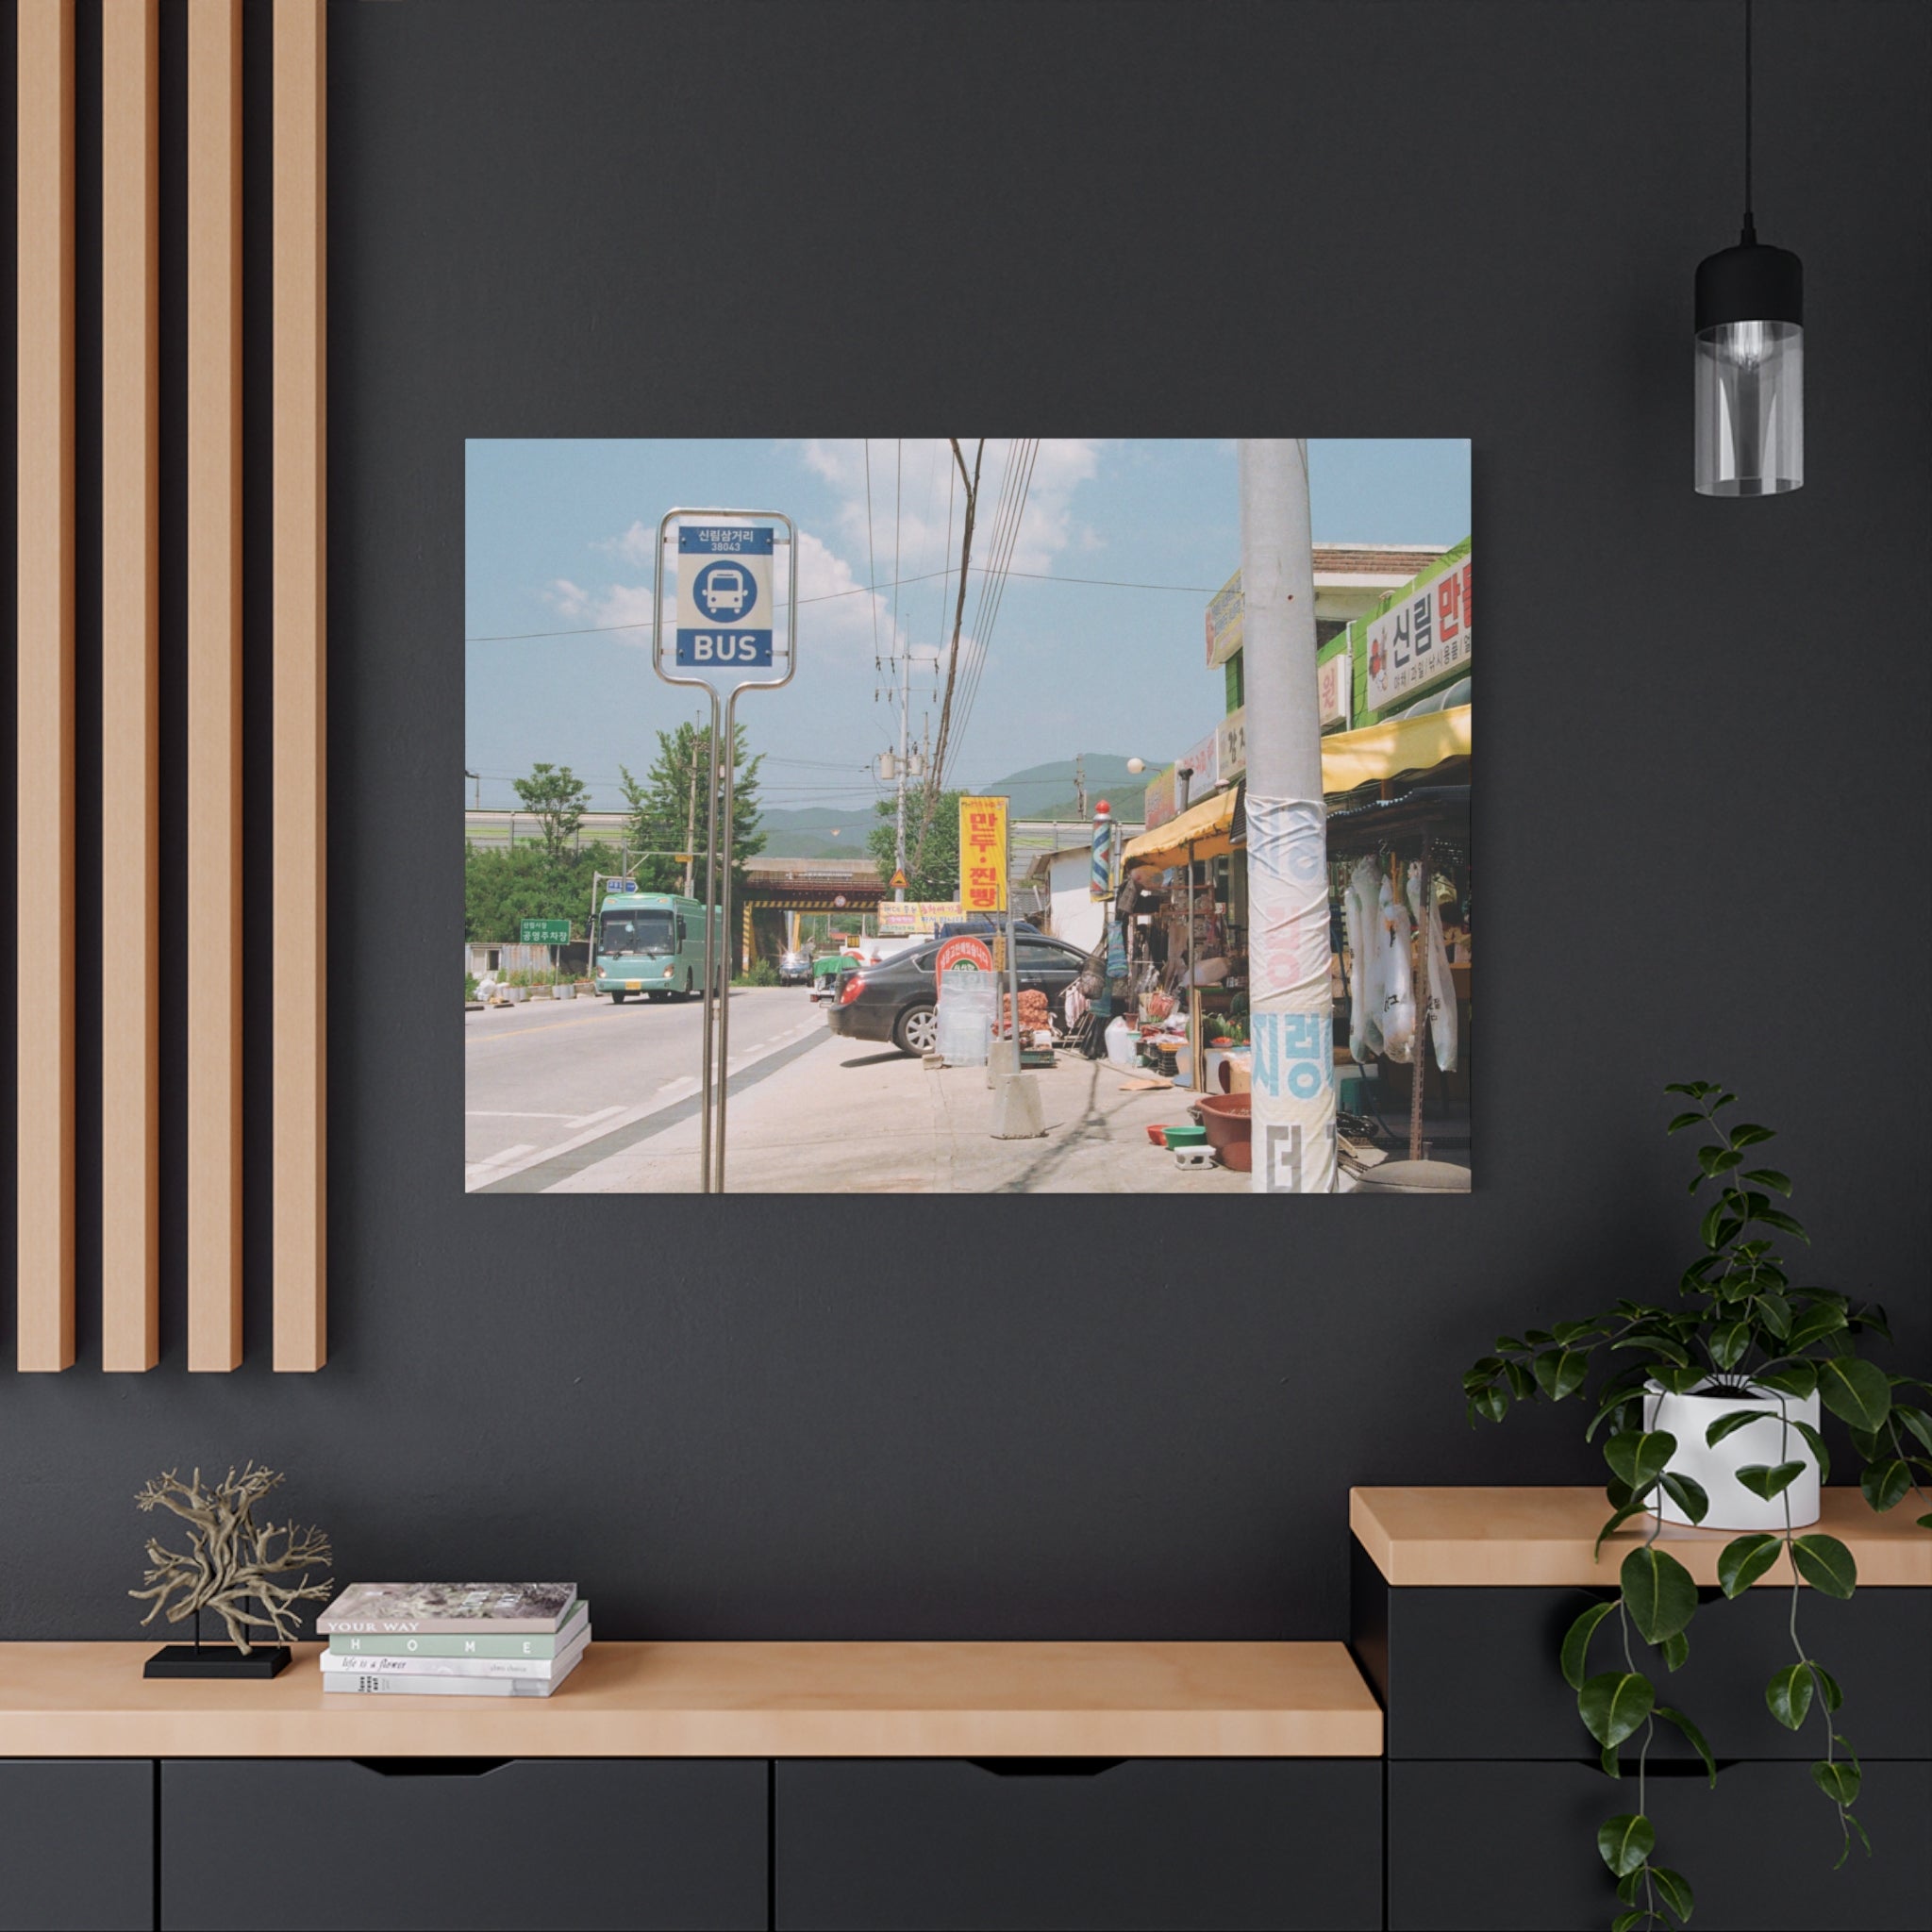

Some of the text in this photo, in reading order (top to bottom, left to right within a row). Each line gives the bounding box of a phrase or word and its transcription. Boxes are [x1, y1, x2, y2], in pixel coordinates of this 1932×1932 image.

[698, 529, 754, 542] 신림삼거리
[711, 541, 741, 552] 38043
[1392, 593, 1431, 668] 신림
[694, 635, 757, 661] BUS
[523, 931, 568, 941] 공영주차장
[327, 1621, 420, 1633] YOUR WAY
[377, 1657, 408, 1672] flower
